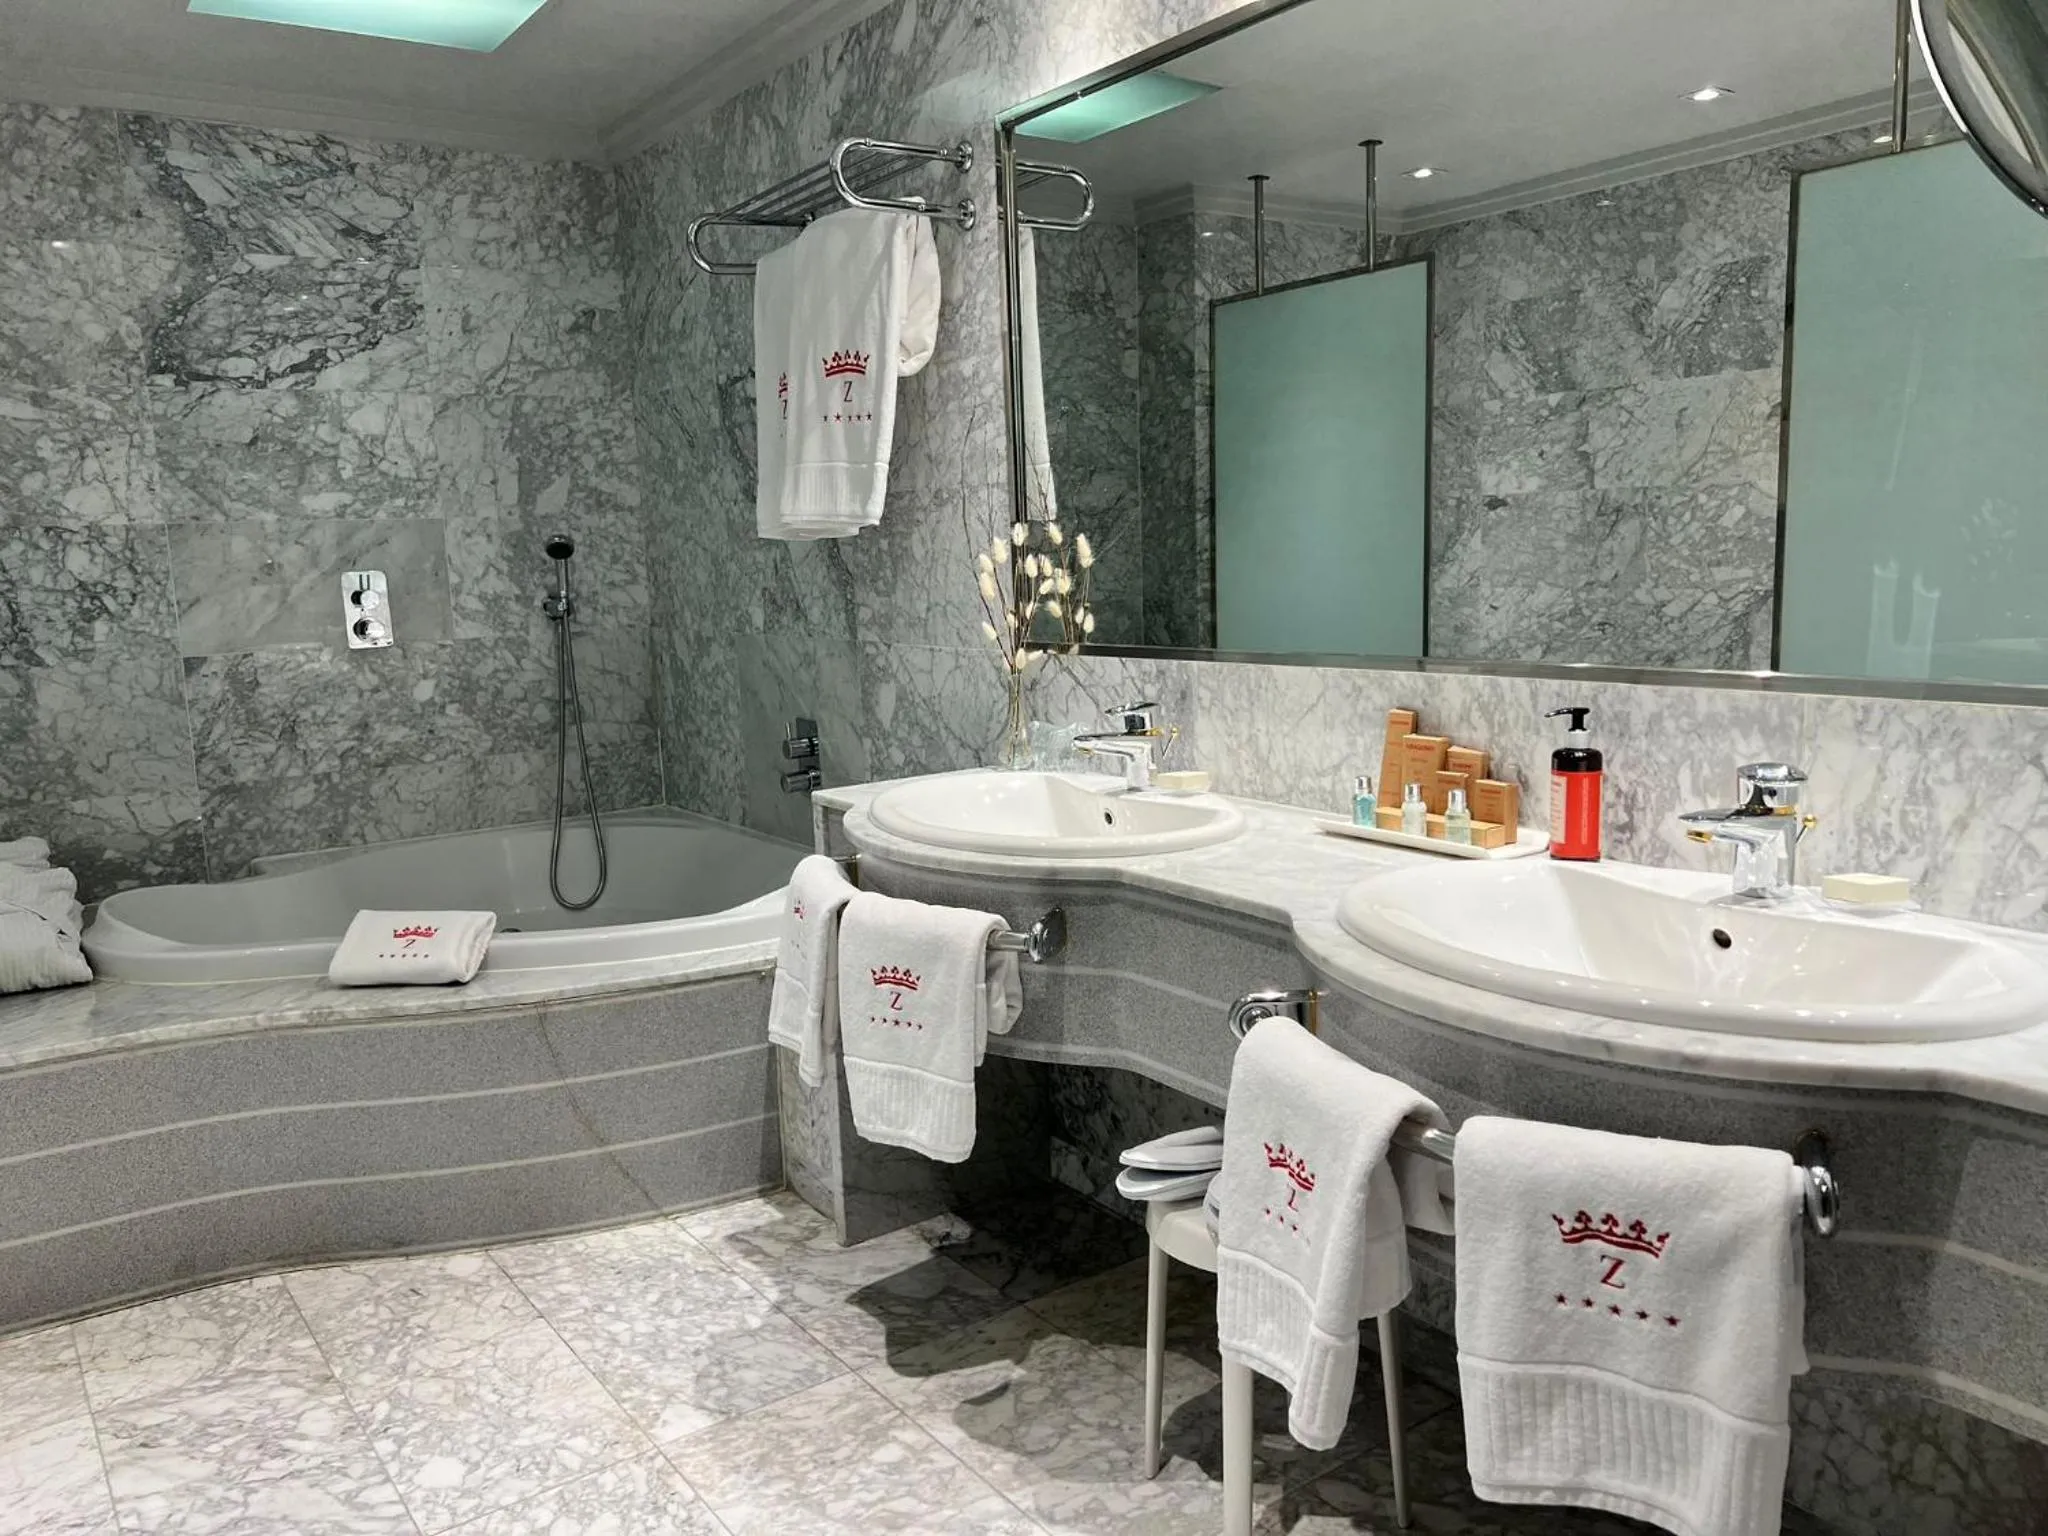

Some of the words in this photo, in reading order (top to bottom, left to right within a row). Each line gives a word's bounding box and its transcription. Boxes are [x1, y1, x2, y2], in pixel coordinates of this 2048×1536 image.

[843, 380, 853, 403] Z
[890, 990, 903, 1011] Z
[1600, 1254, 1626, 1289] Z
